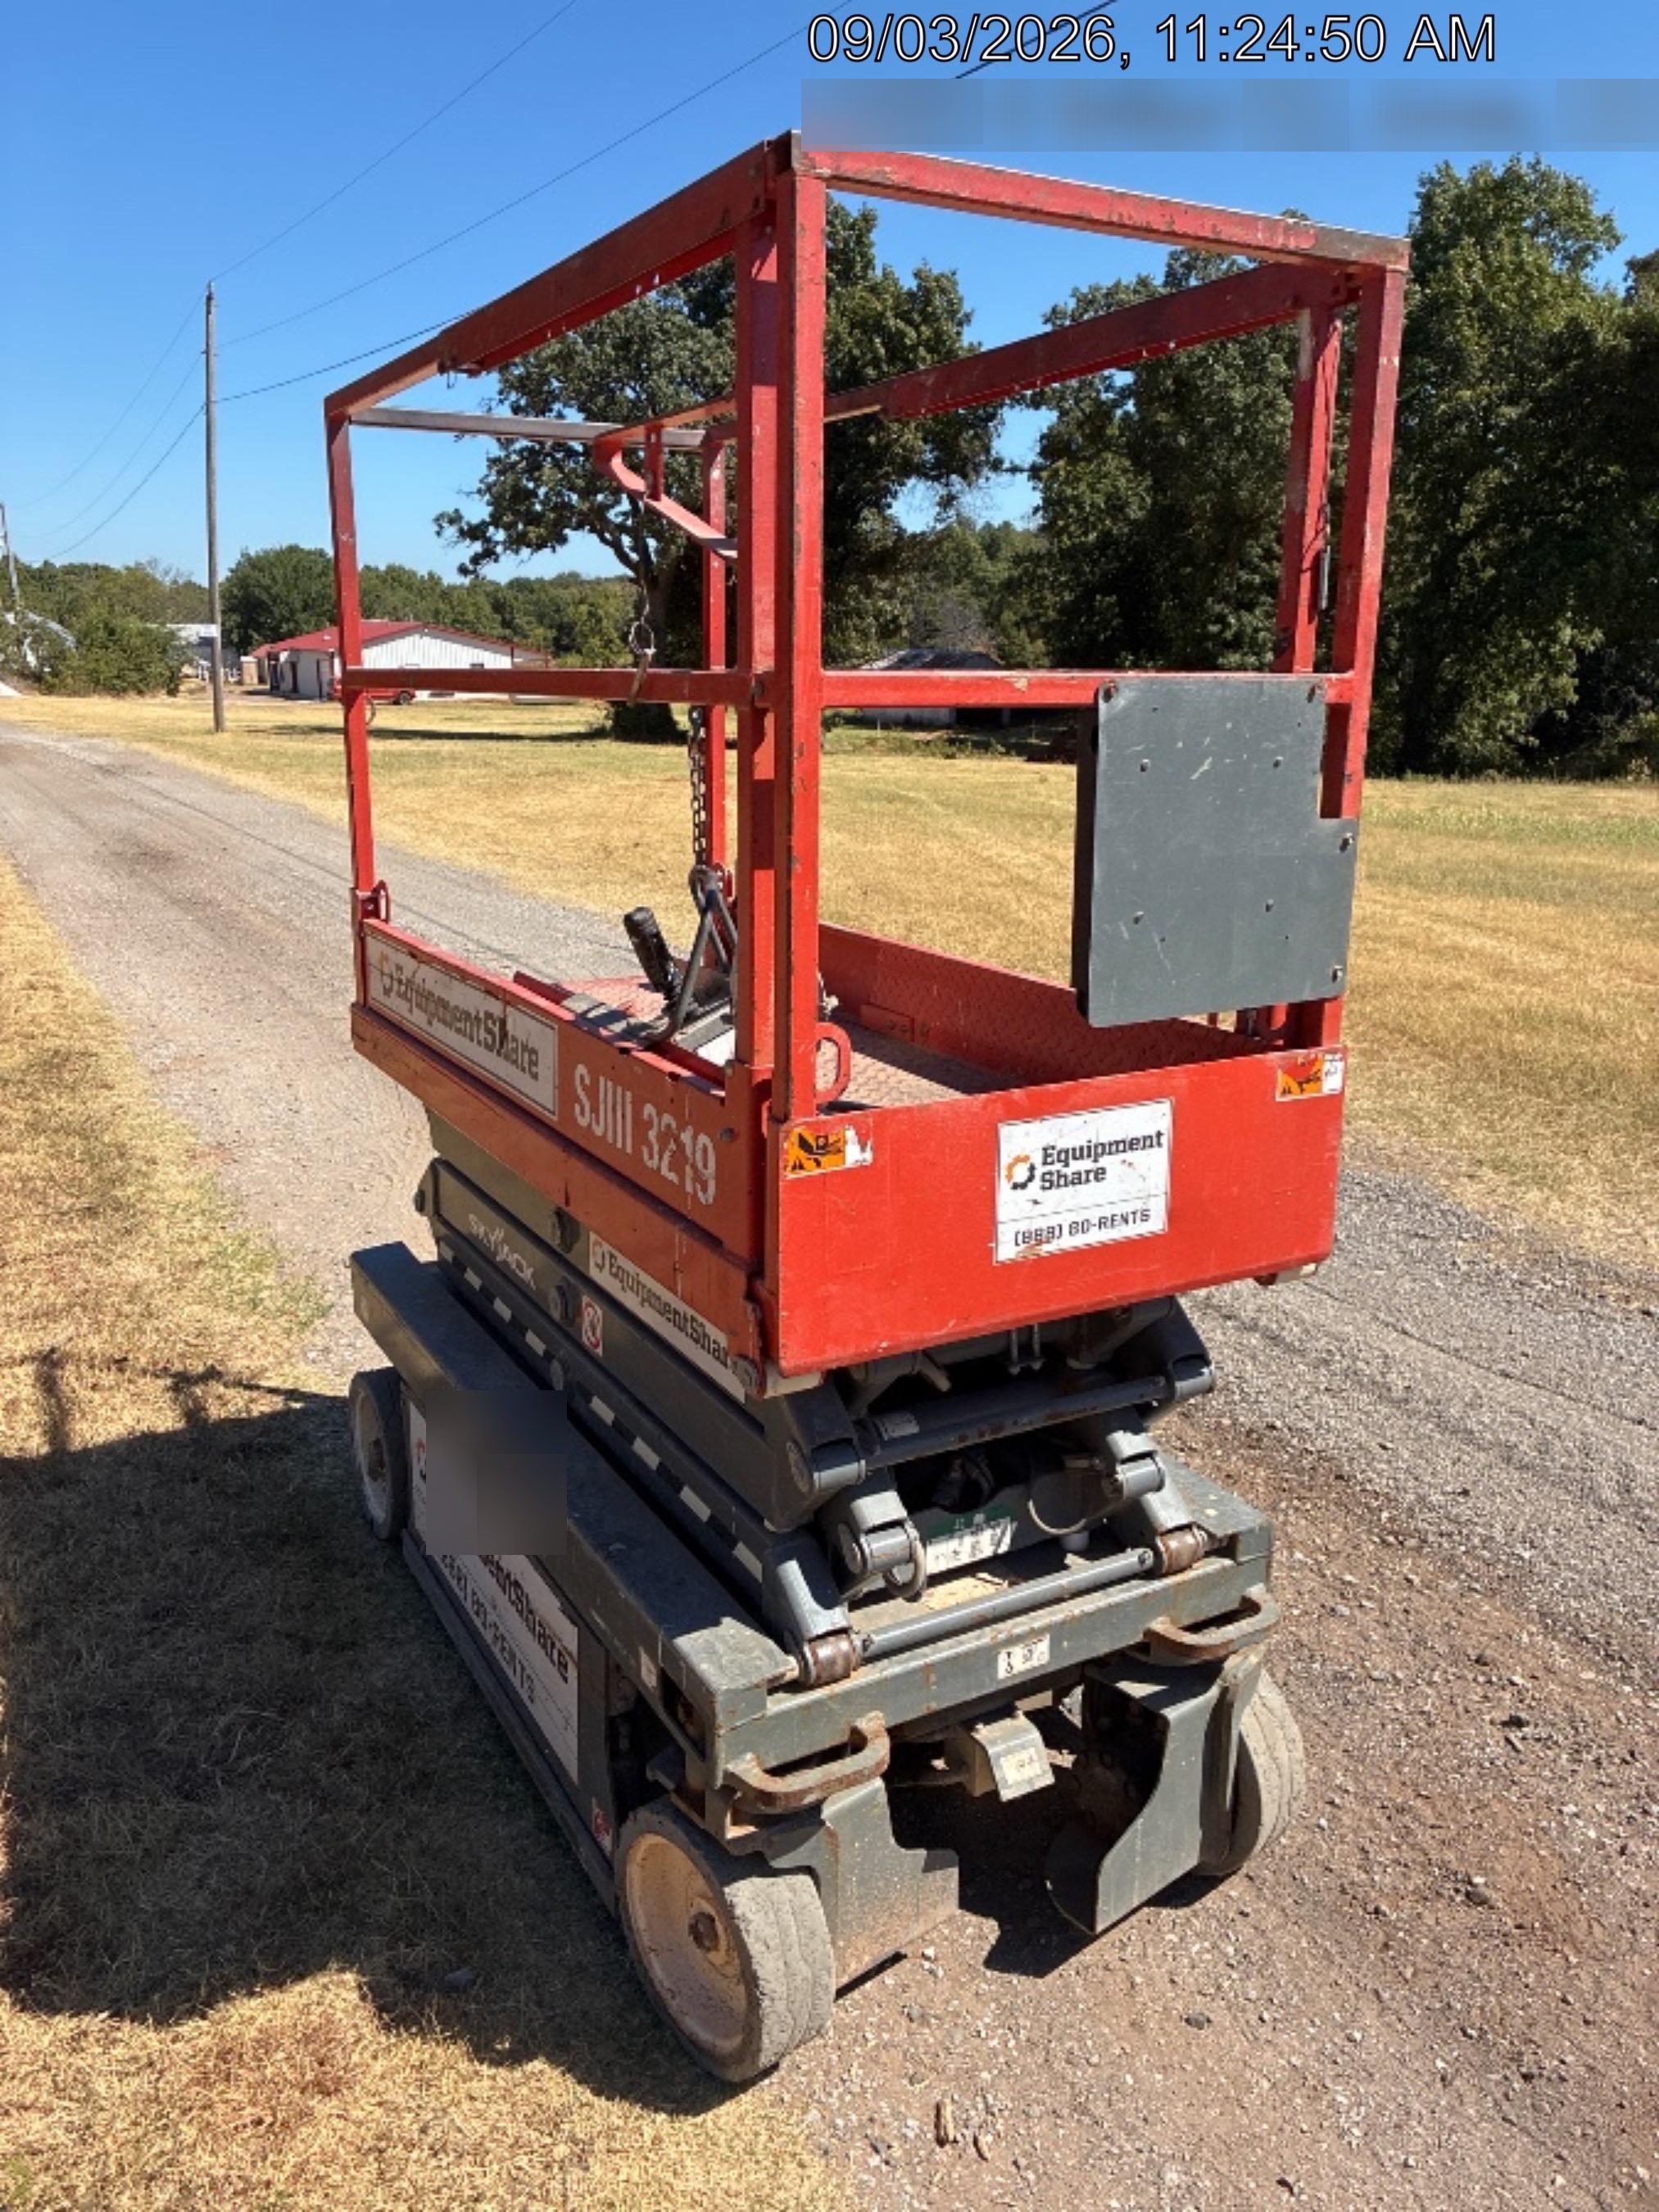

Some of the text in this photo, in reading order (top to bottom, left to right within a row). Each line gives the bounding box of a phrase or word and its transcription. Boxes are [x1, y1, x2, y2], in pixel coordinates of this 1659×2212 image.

[395, 962, 539, 1082] EquipmentShare
[642, 1103, 715, 1205] 3219
[1041, 1130, 1164, 1167] Equipment
[1040, 1166, 1106, 1191] Share
[1068, 1208, 1151, 1237] 80-RENTS
